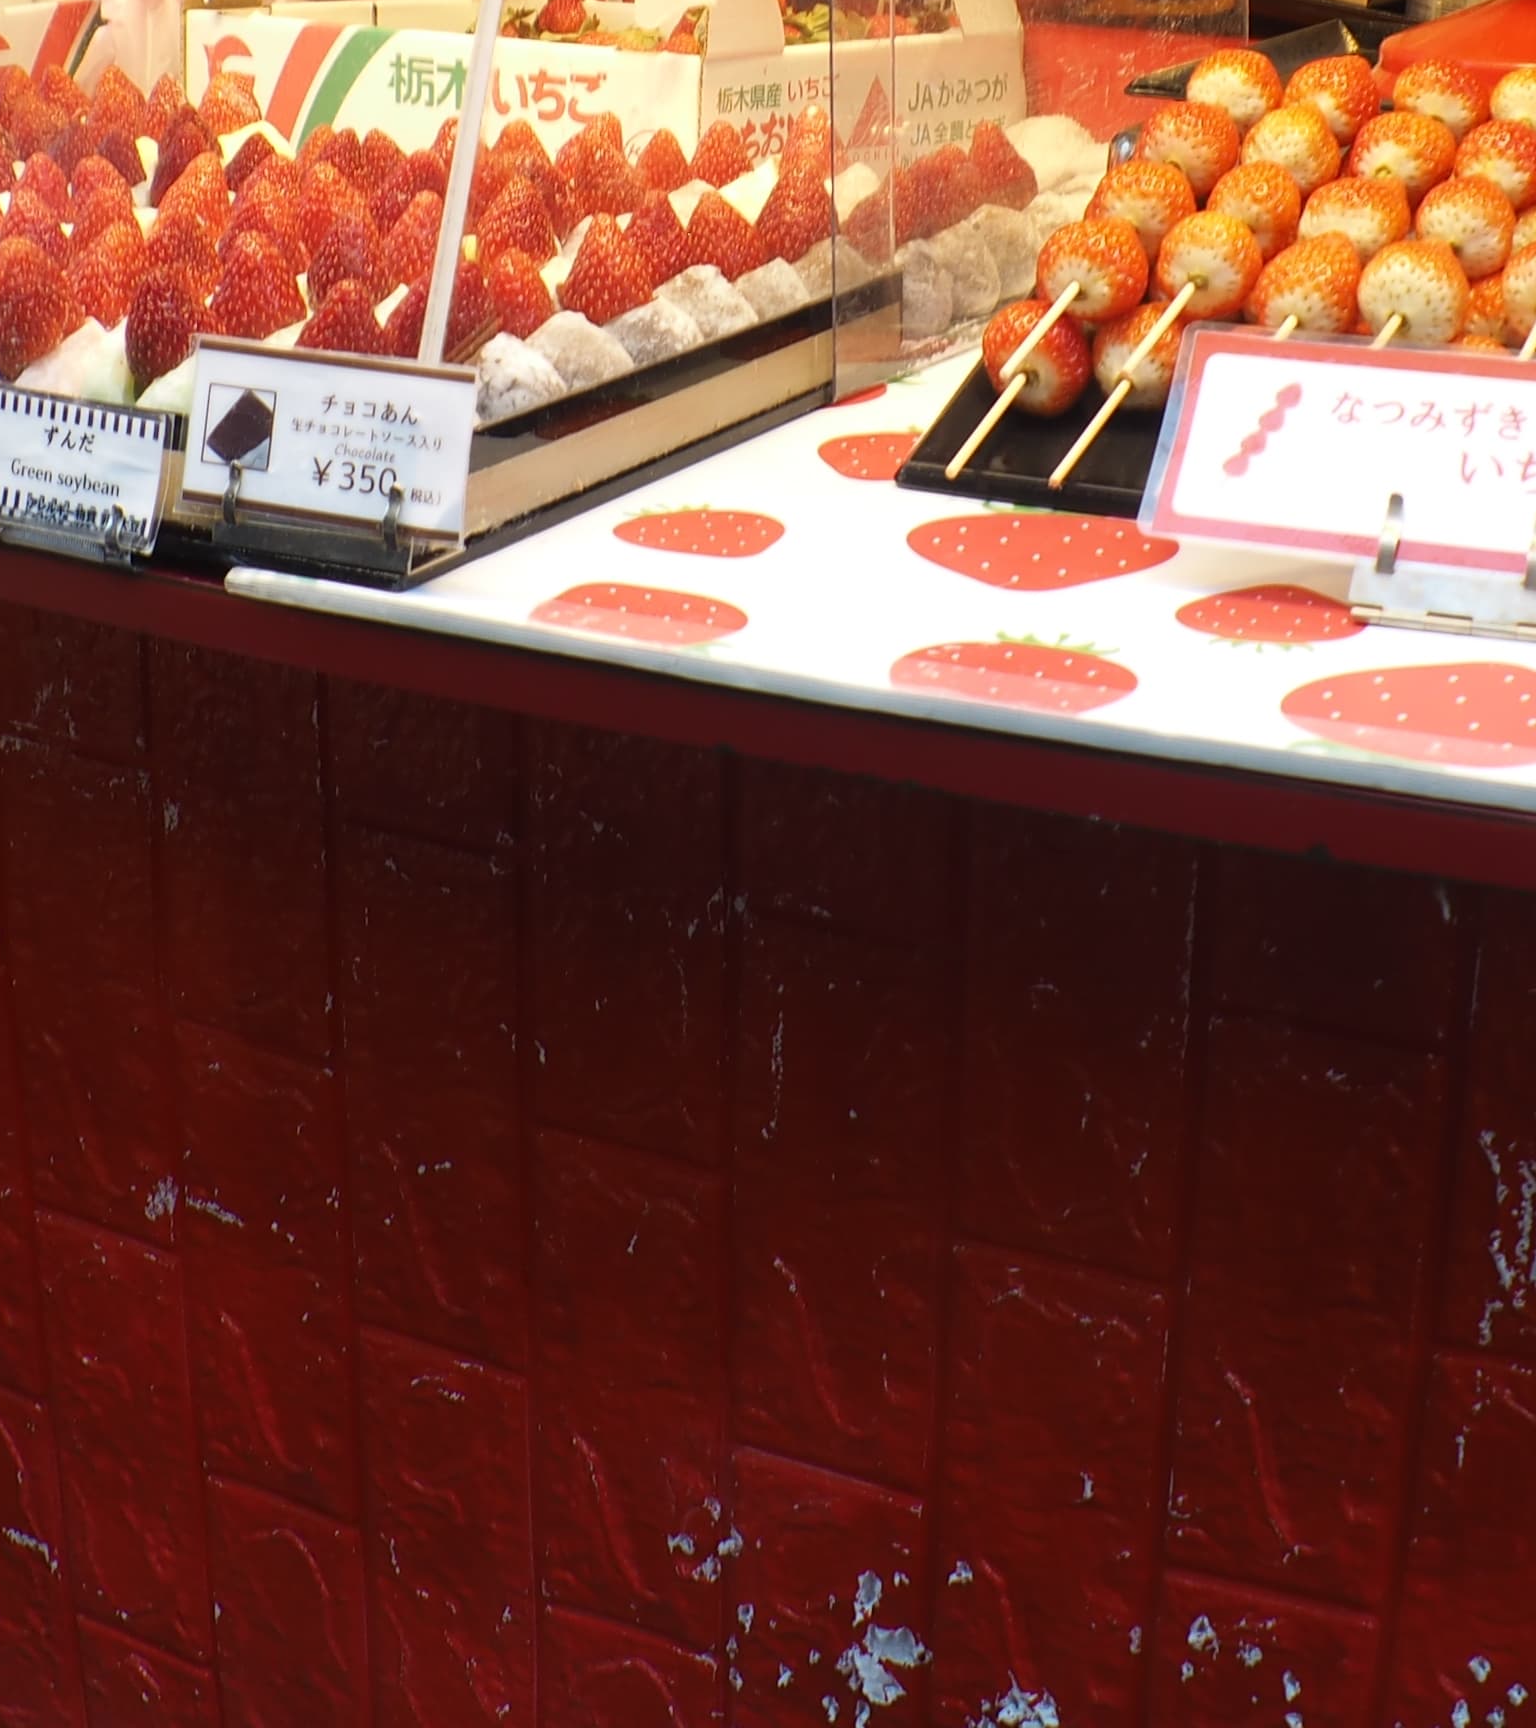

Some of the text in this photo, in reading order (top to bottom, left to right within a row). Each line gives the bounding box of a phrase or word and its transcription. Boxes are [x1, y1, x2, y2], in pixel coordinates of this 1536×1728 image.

[908, 73, 1009, 112] JAかみつが
[320, 393, 419, 427] チョコあん
[1330, 389, 1529, 442] なつみずき
[43, 424, 96, 455] ずんだ
[291, 416, 443, 453] 生チョコレートソース入り
[334, 442, 396, 464] Chocolate
[11, 456, 121, 498] Green soybean
[312, 456, 398, 498] ¥350
